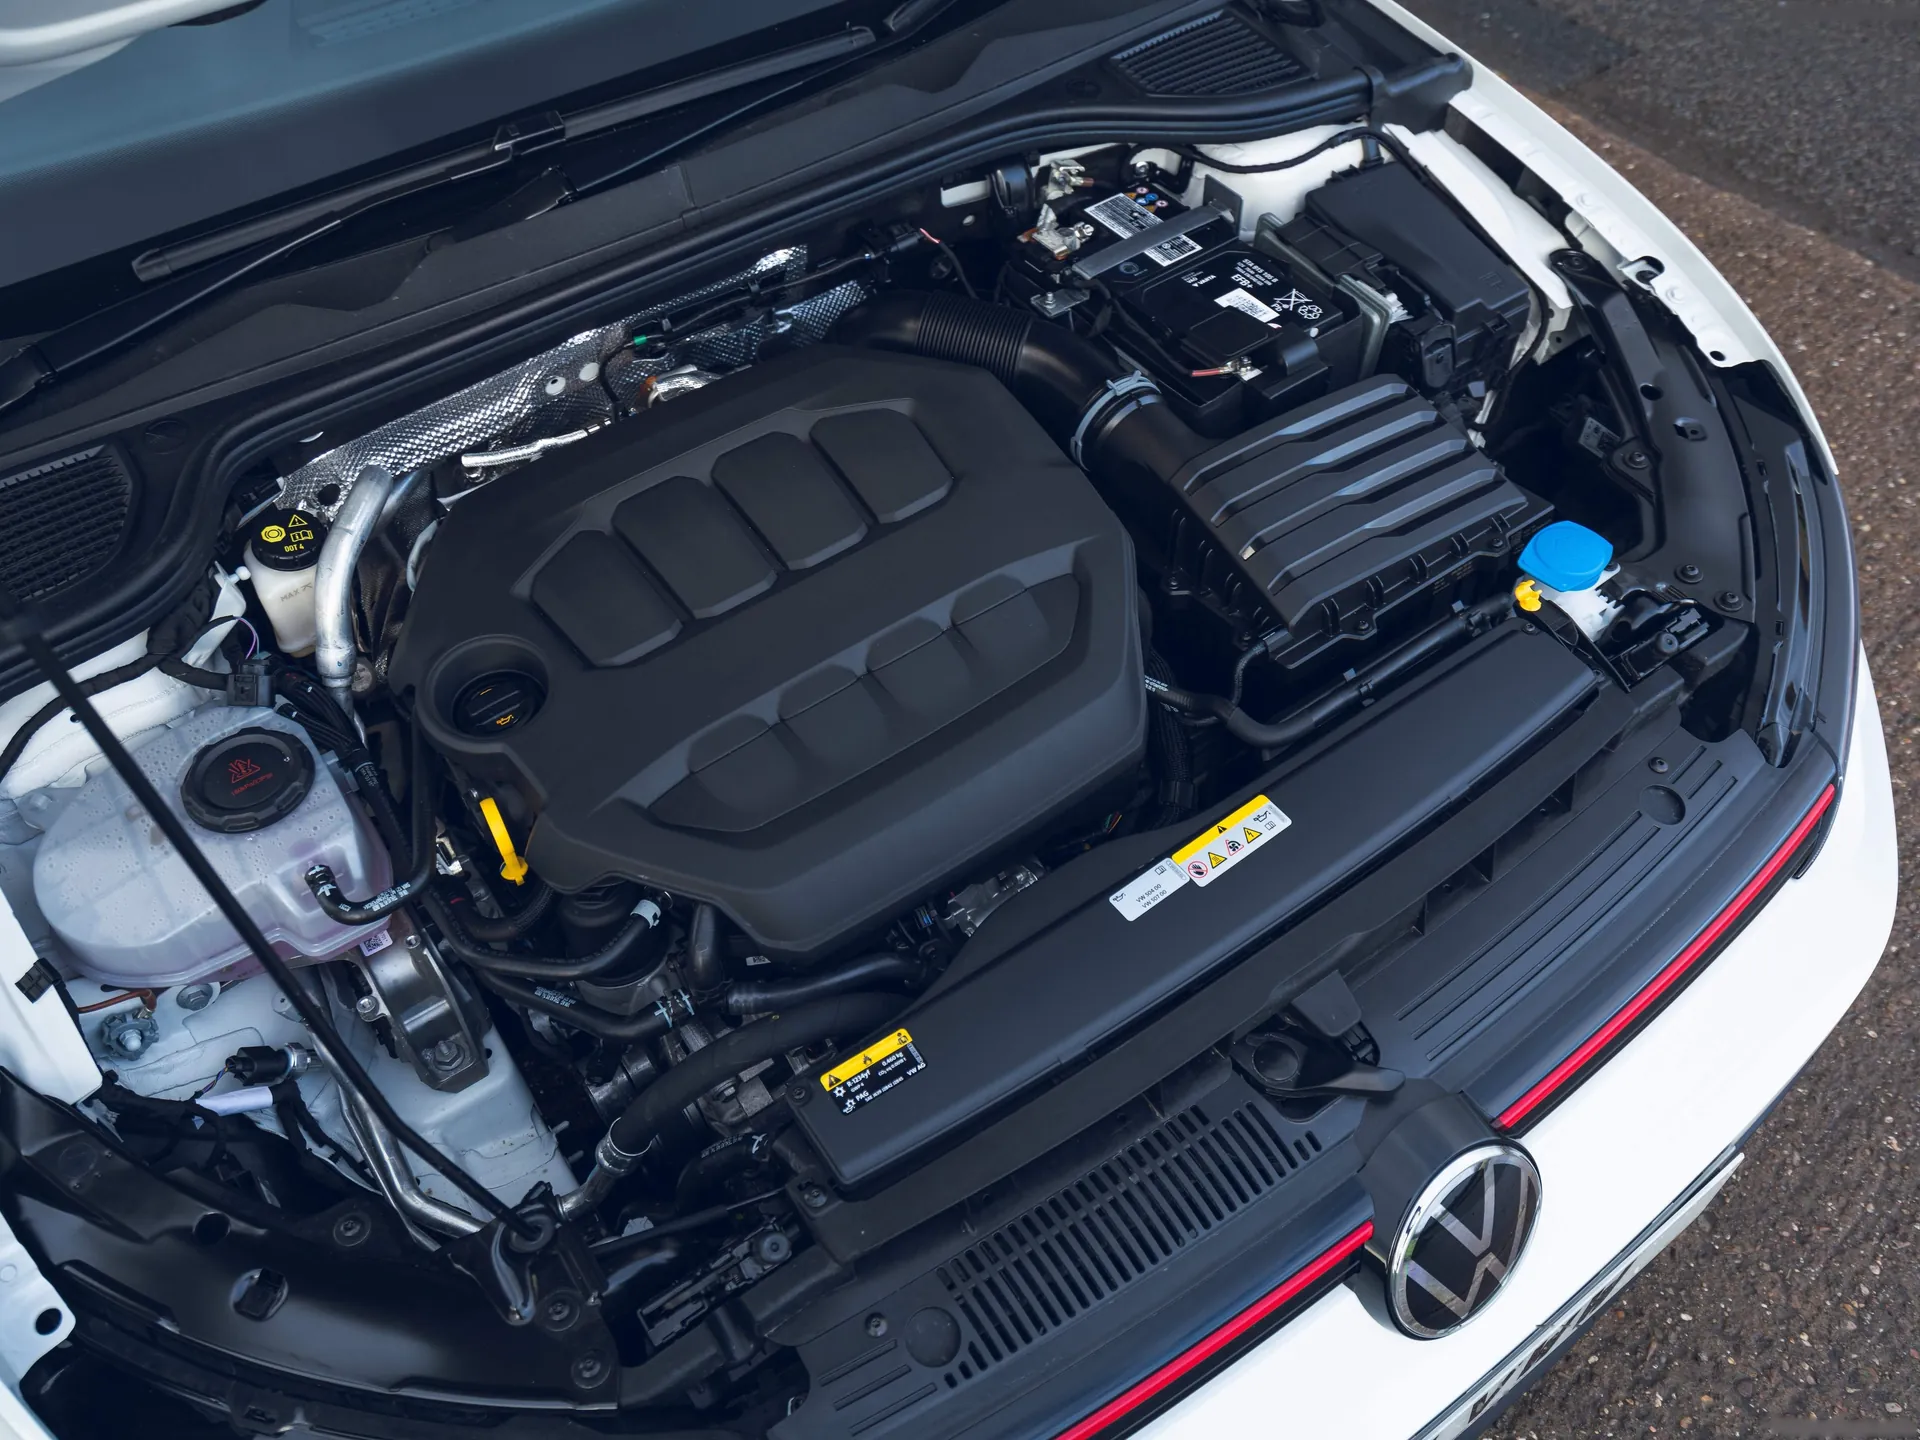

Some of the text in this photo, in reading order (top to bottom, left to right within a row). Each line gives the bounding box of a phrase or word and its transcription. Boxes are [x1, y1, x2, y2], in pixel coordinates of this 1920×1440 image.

[1198, 274, 1216, 285] VARTA
[284, 544, 298, 552] DOT
[280, 590, 299, 602] MAX
[1145, 888, 1154, 896] 504
[846, 1069, 871, 1087] R-1234yf
[855, 1091, 869, 1101] PAG
